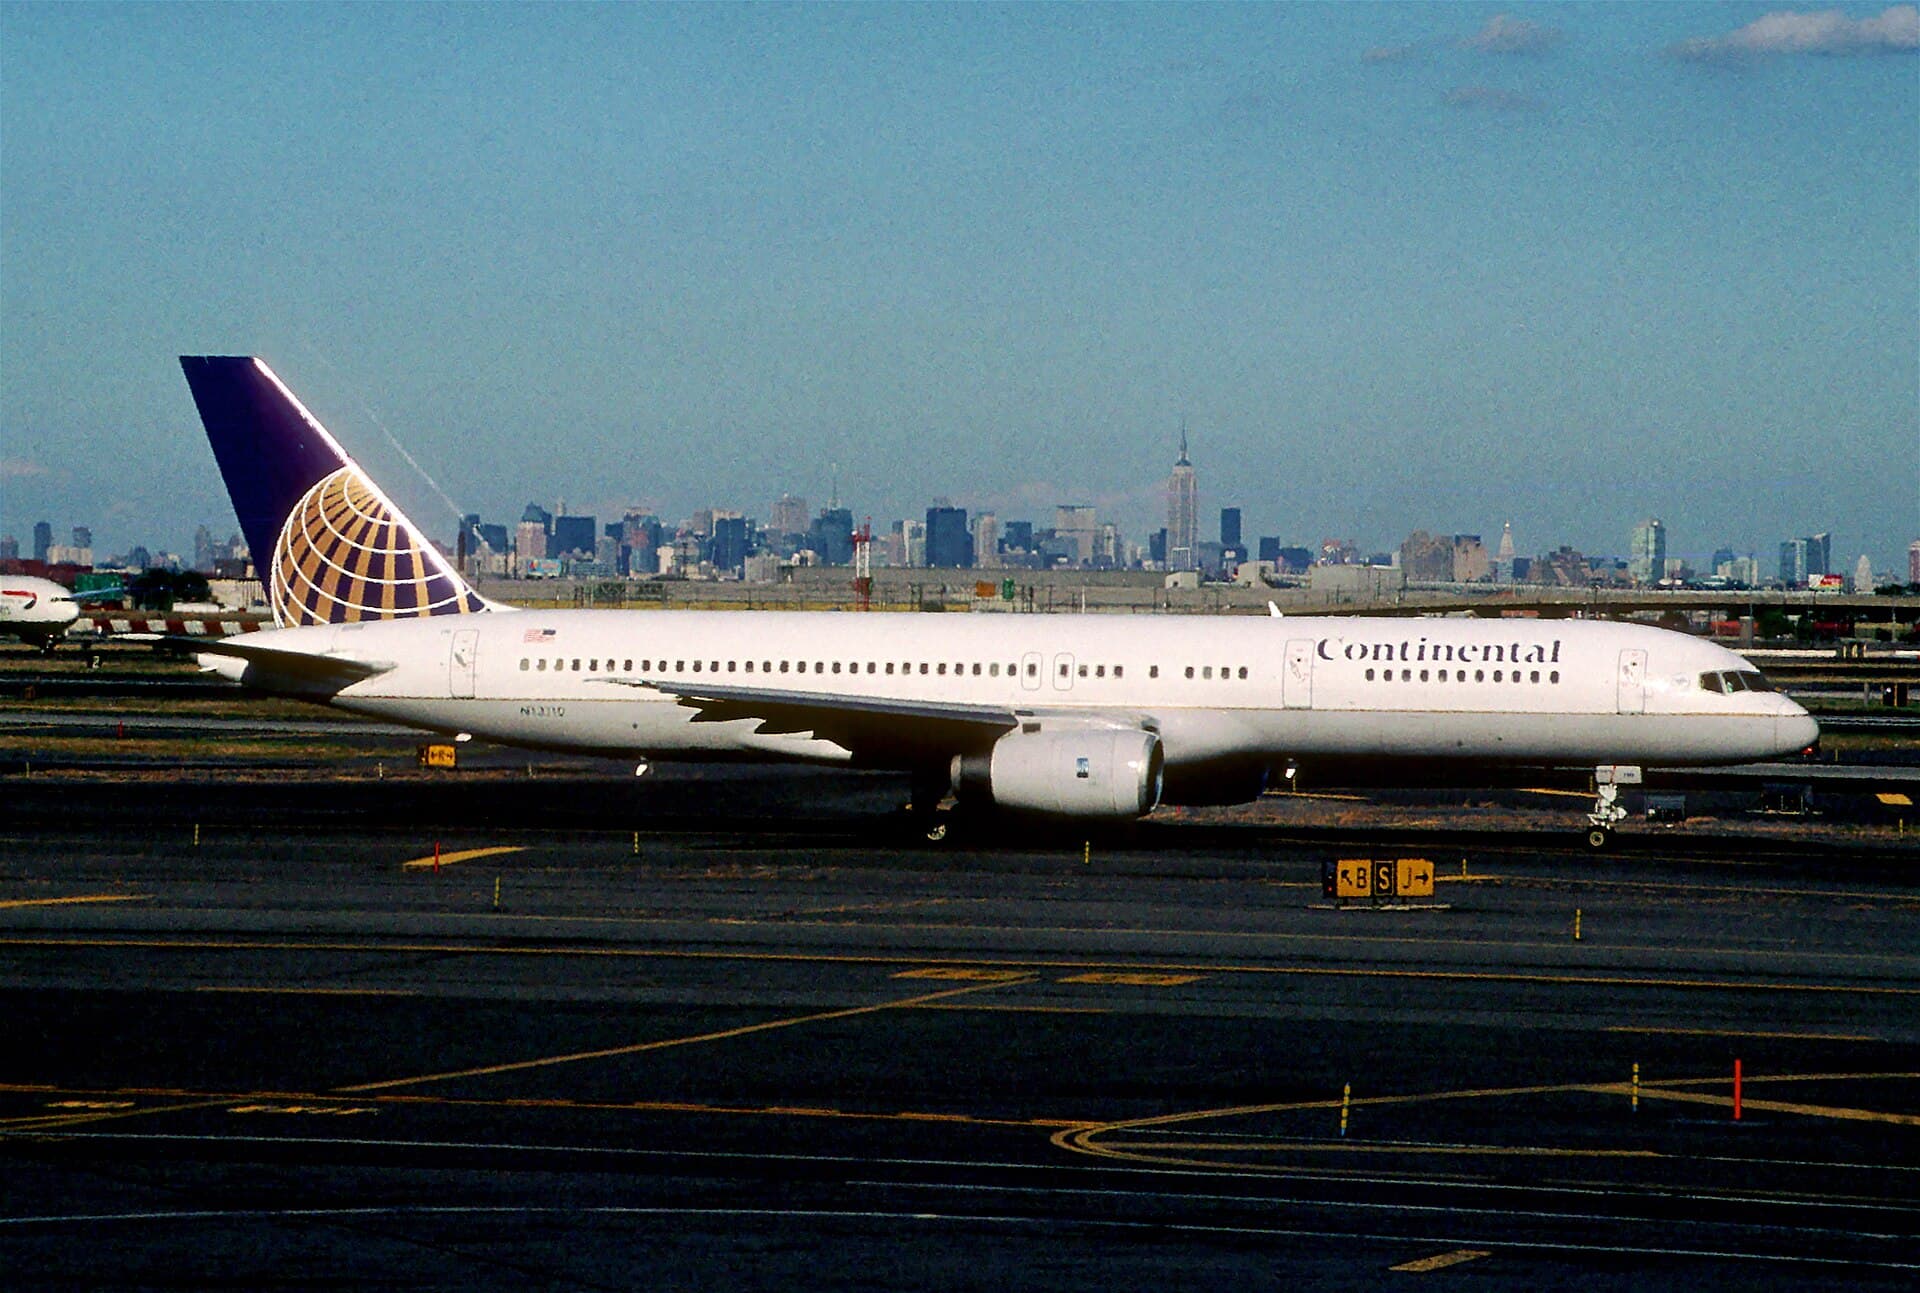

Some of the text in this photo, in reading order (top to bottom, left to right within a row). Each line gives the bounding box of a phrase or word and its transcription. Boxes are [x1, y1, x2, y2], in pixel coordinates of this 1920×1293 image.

[1317, 637, 1561, 663] Continental
[1356, 866, 1412, 890] B S J
